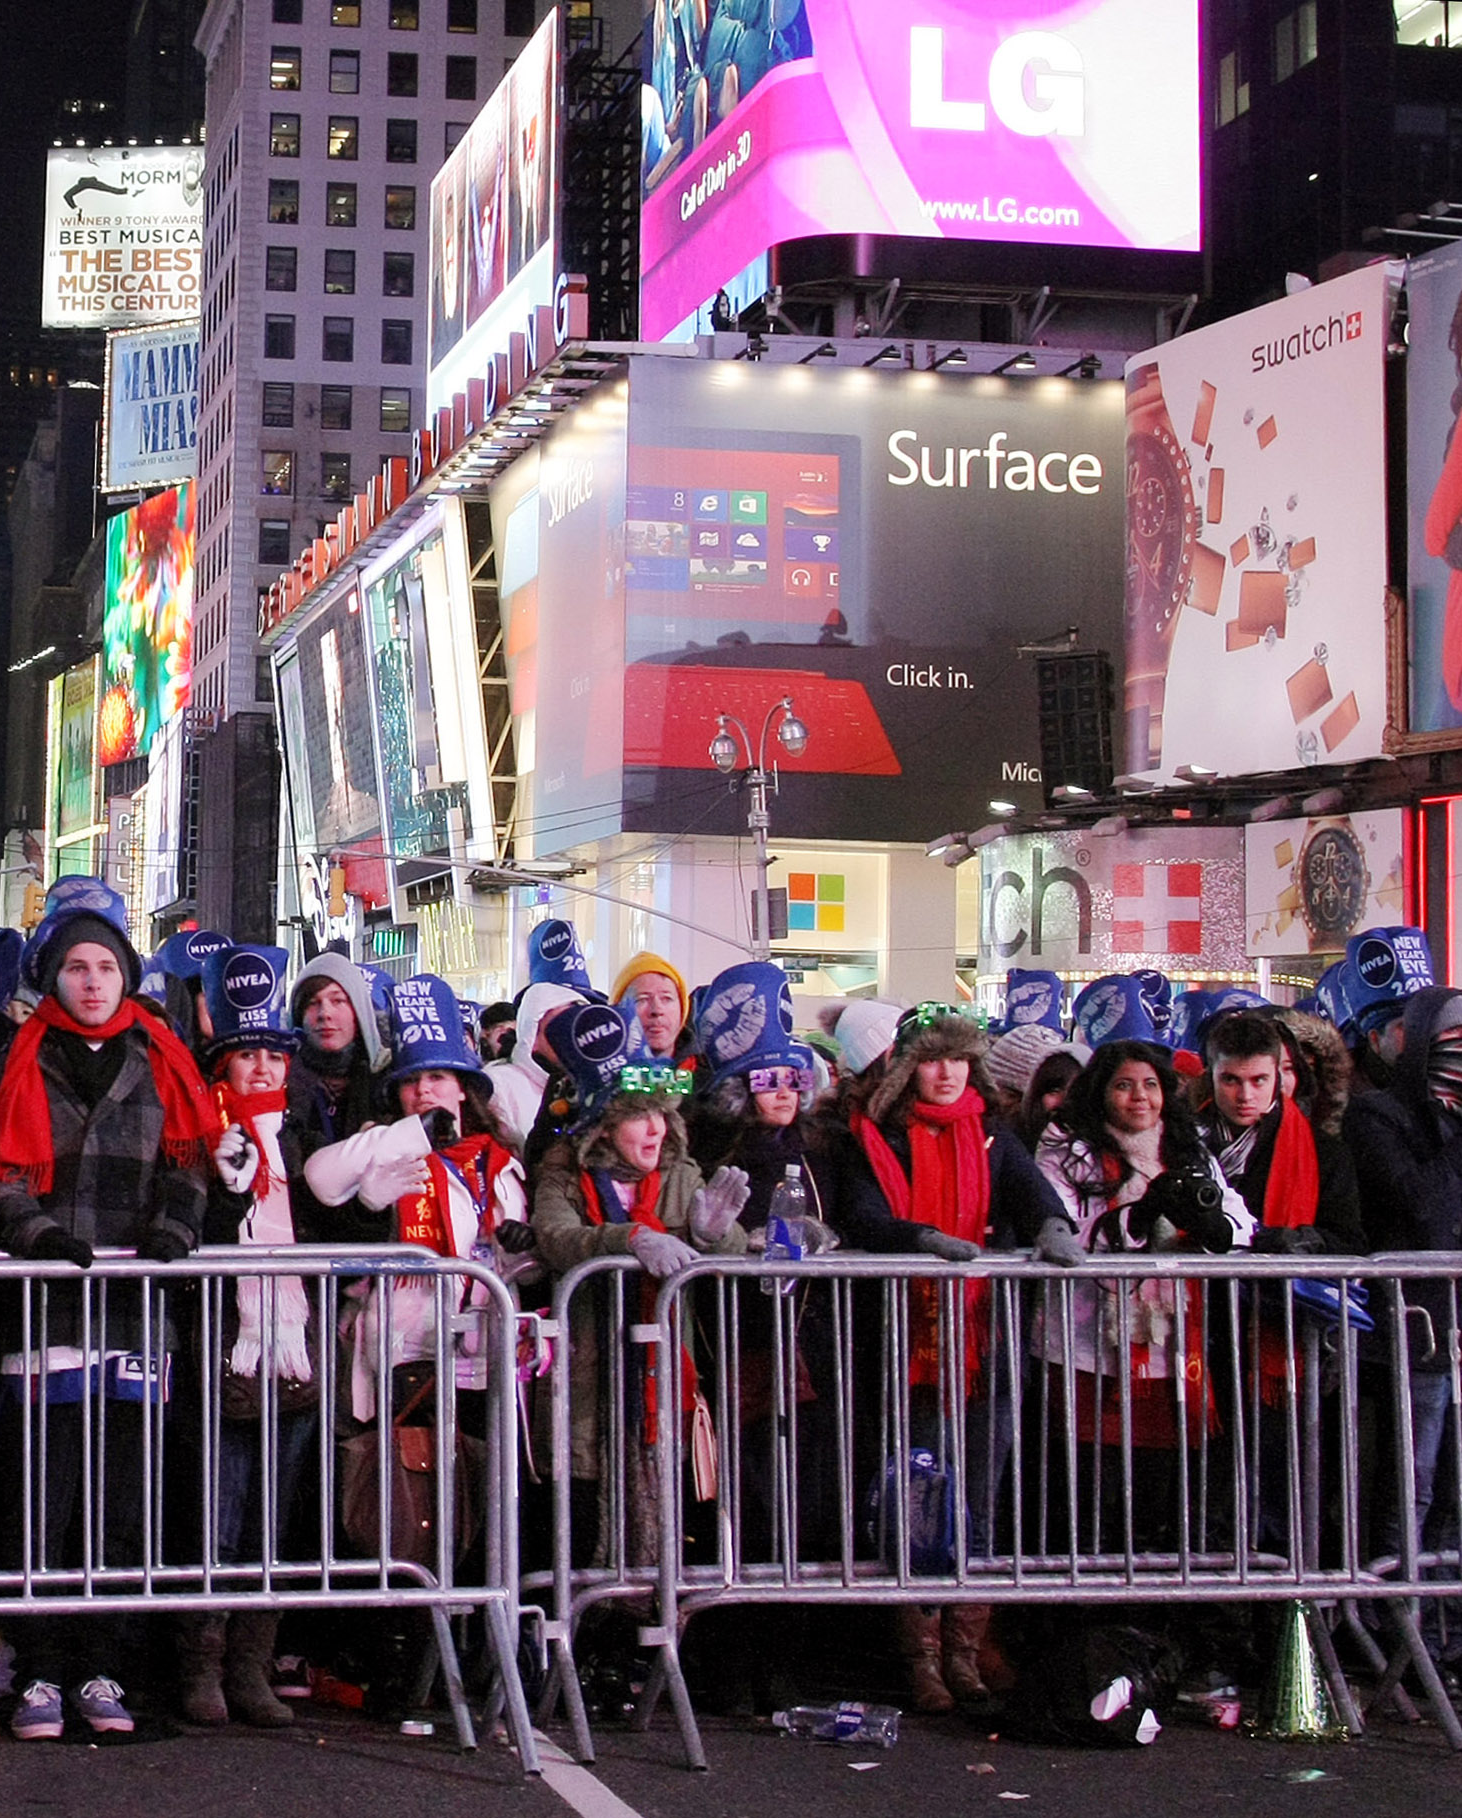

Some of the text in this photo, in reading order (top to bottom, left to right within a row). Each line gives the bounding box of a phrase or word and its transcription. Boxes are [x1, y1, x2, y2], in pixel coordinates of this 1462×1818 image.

[910, 26, 1086, 137] LG
[121, 170, 181, 185] MORM
[680, 130, 751, 221] Call of Duty in 3D
[60, 216, 111, 226] WINNER
[114, 217, 123, 226] 9
[125, 216, 161, 226] TONY
[919, 197, 1080, 226] www.LG.com
[60, 230, 111, 244] BEST
[58, 274, 171, 293] MUSICAL
[57, 297, 105, 311] THIS
[1251, 315, 1344, 373] swatch
[411, 272, 580, 487] BUILDING
[139, 395, 198, 455] MIA!
[888, 429, 1104, 496] Surface
[543, 456, 595, 528] Surface
[674, 491, 684, 508] 8
[886, 664, 975, 689] Click in.
[541, 931, 570, 950] NIVEA
[1392, 936, 1422, 950] NEW
[1359, 953, 1391, 975] NIVEA
[1399, 960, 1431, 975] EVE
[226, 972, 271, 991] NIVEA
[394, 981, 433, 997] NEW
[396, 996, 436, 1007] YEAR'S
[238, 1008, 269, 1023] KISS
[398, 1006, 441, 1023] EVE
[576, 1021, 621, 1047] NIVEA
[597, 1054, 628, 1074] KISS
